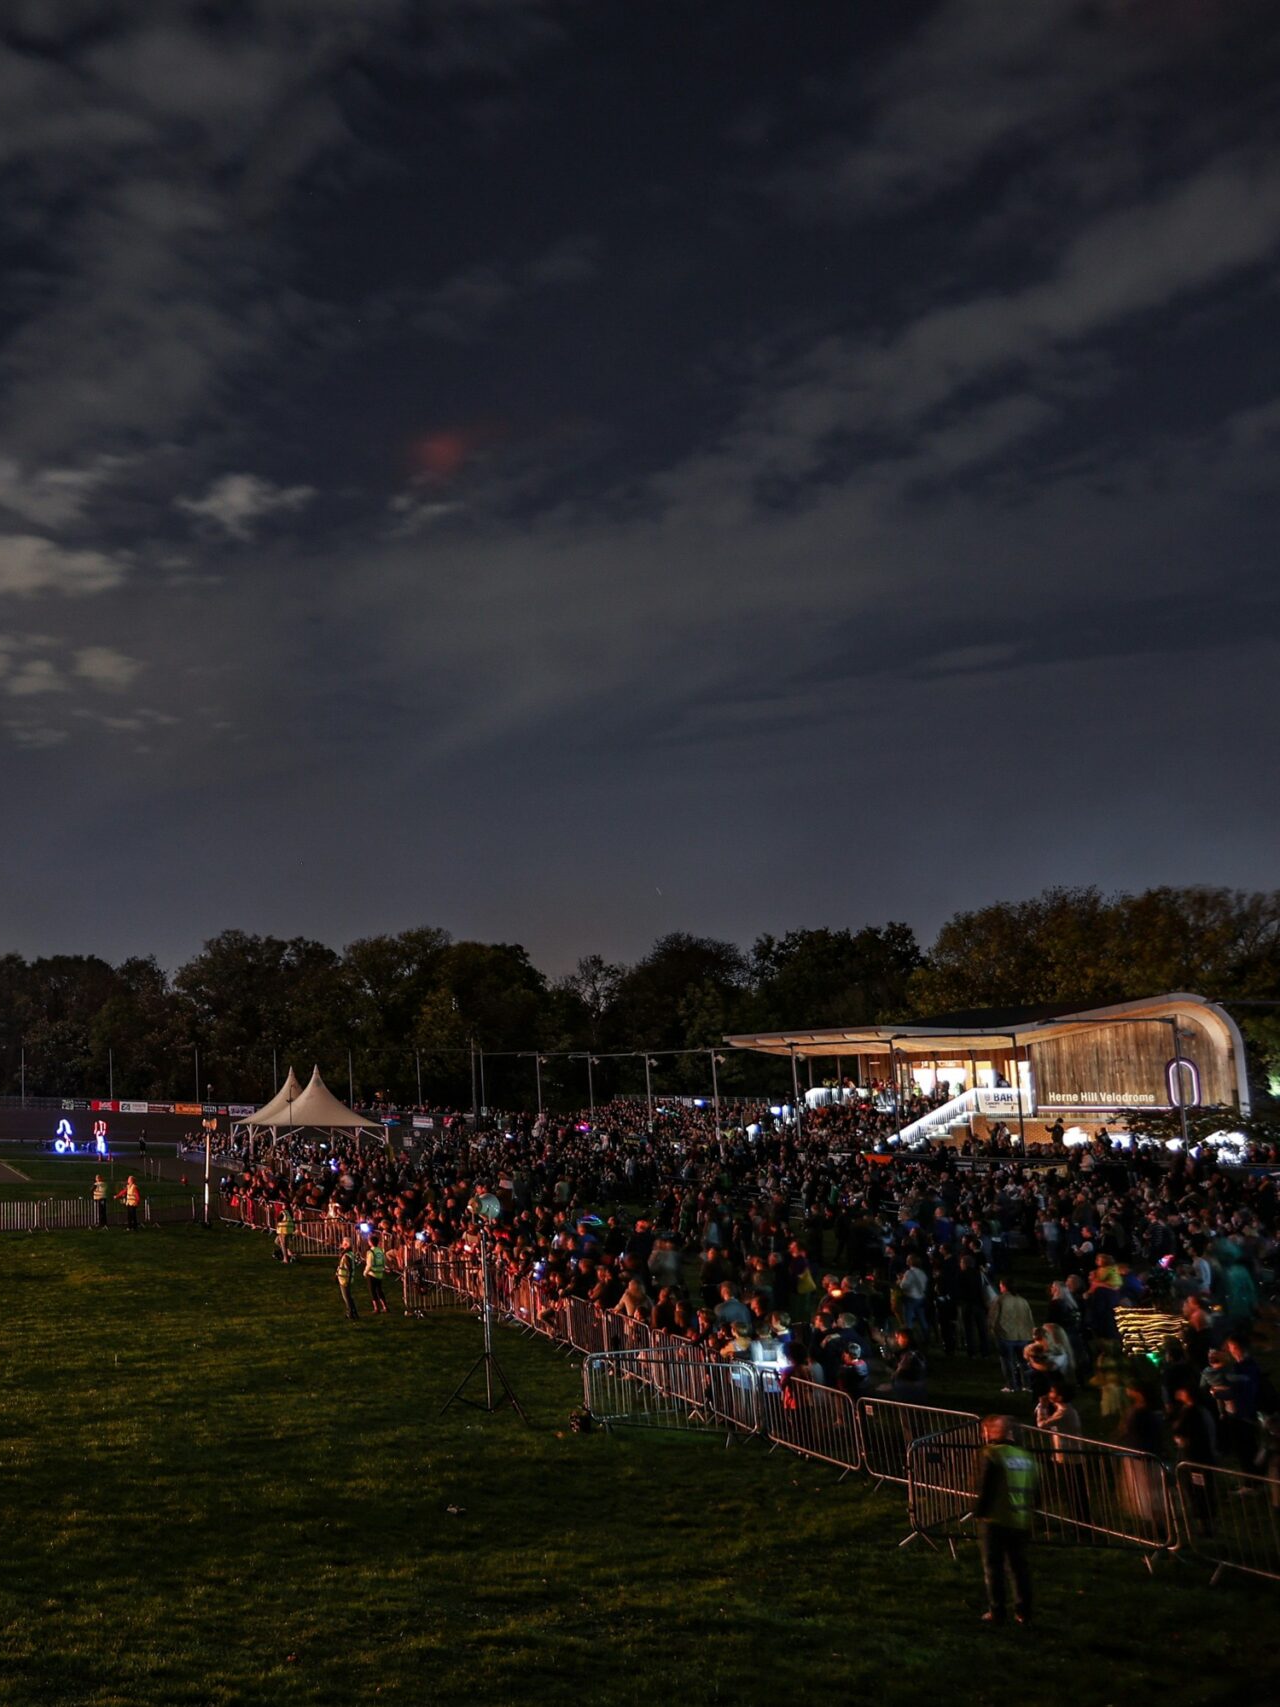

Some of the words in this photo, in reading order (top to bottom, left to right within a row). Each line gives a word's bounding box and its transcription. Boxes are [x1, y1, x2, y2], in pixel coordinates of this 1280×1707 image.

[993, 1093, 1013, 1102] BAR
[1049, 1092, 1078, 1102] Herne
[1080, 1092, 1097, 1102] Hill
[1099, 1092, 1155, 1102] Velodrome
